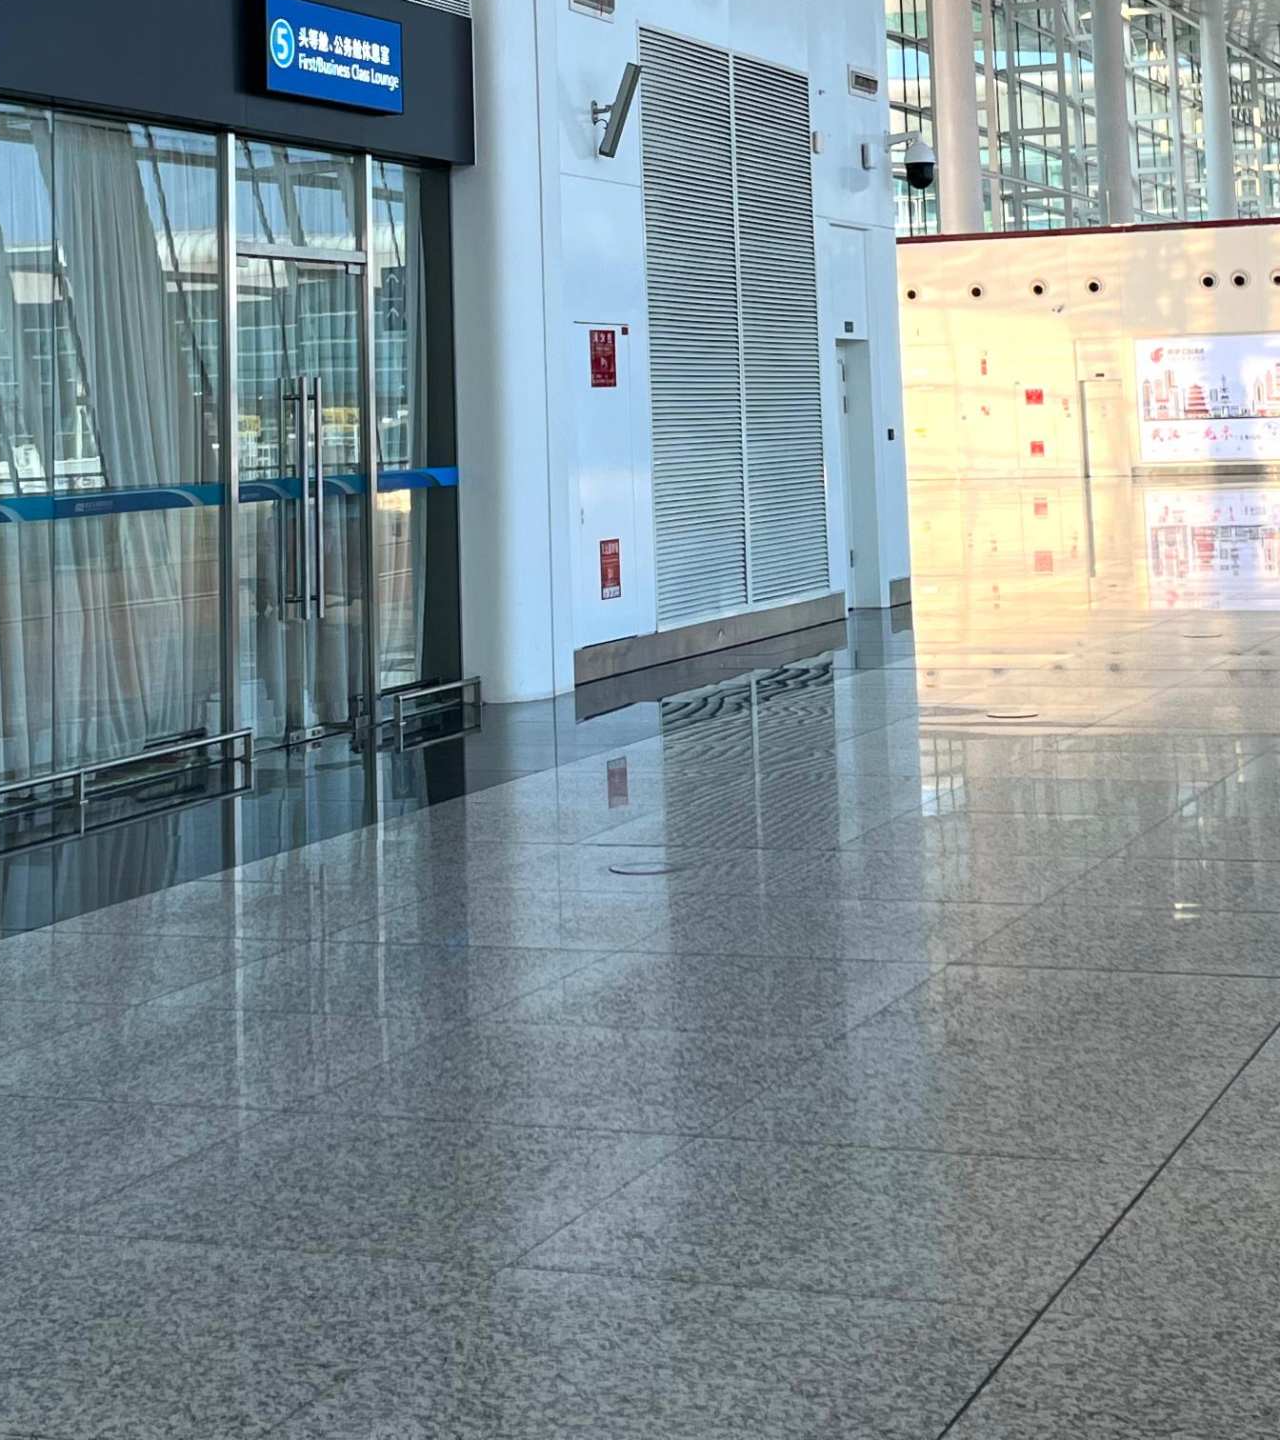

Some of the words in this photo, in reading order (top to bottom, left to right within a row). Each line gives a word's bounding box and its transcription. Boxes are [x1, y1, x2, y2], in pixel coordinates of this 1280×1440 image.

[276, 27, 289, 60] 5
[298, 27, 390, 65] 头等舱、公务舱休息室
[299, 53, 351, 78] First/Business
[352, 64, 370, 82] Class
[371, 68, 400, 91] Lounge
